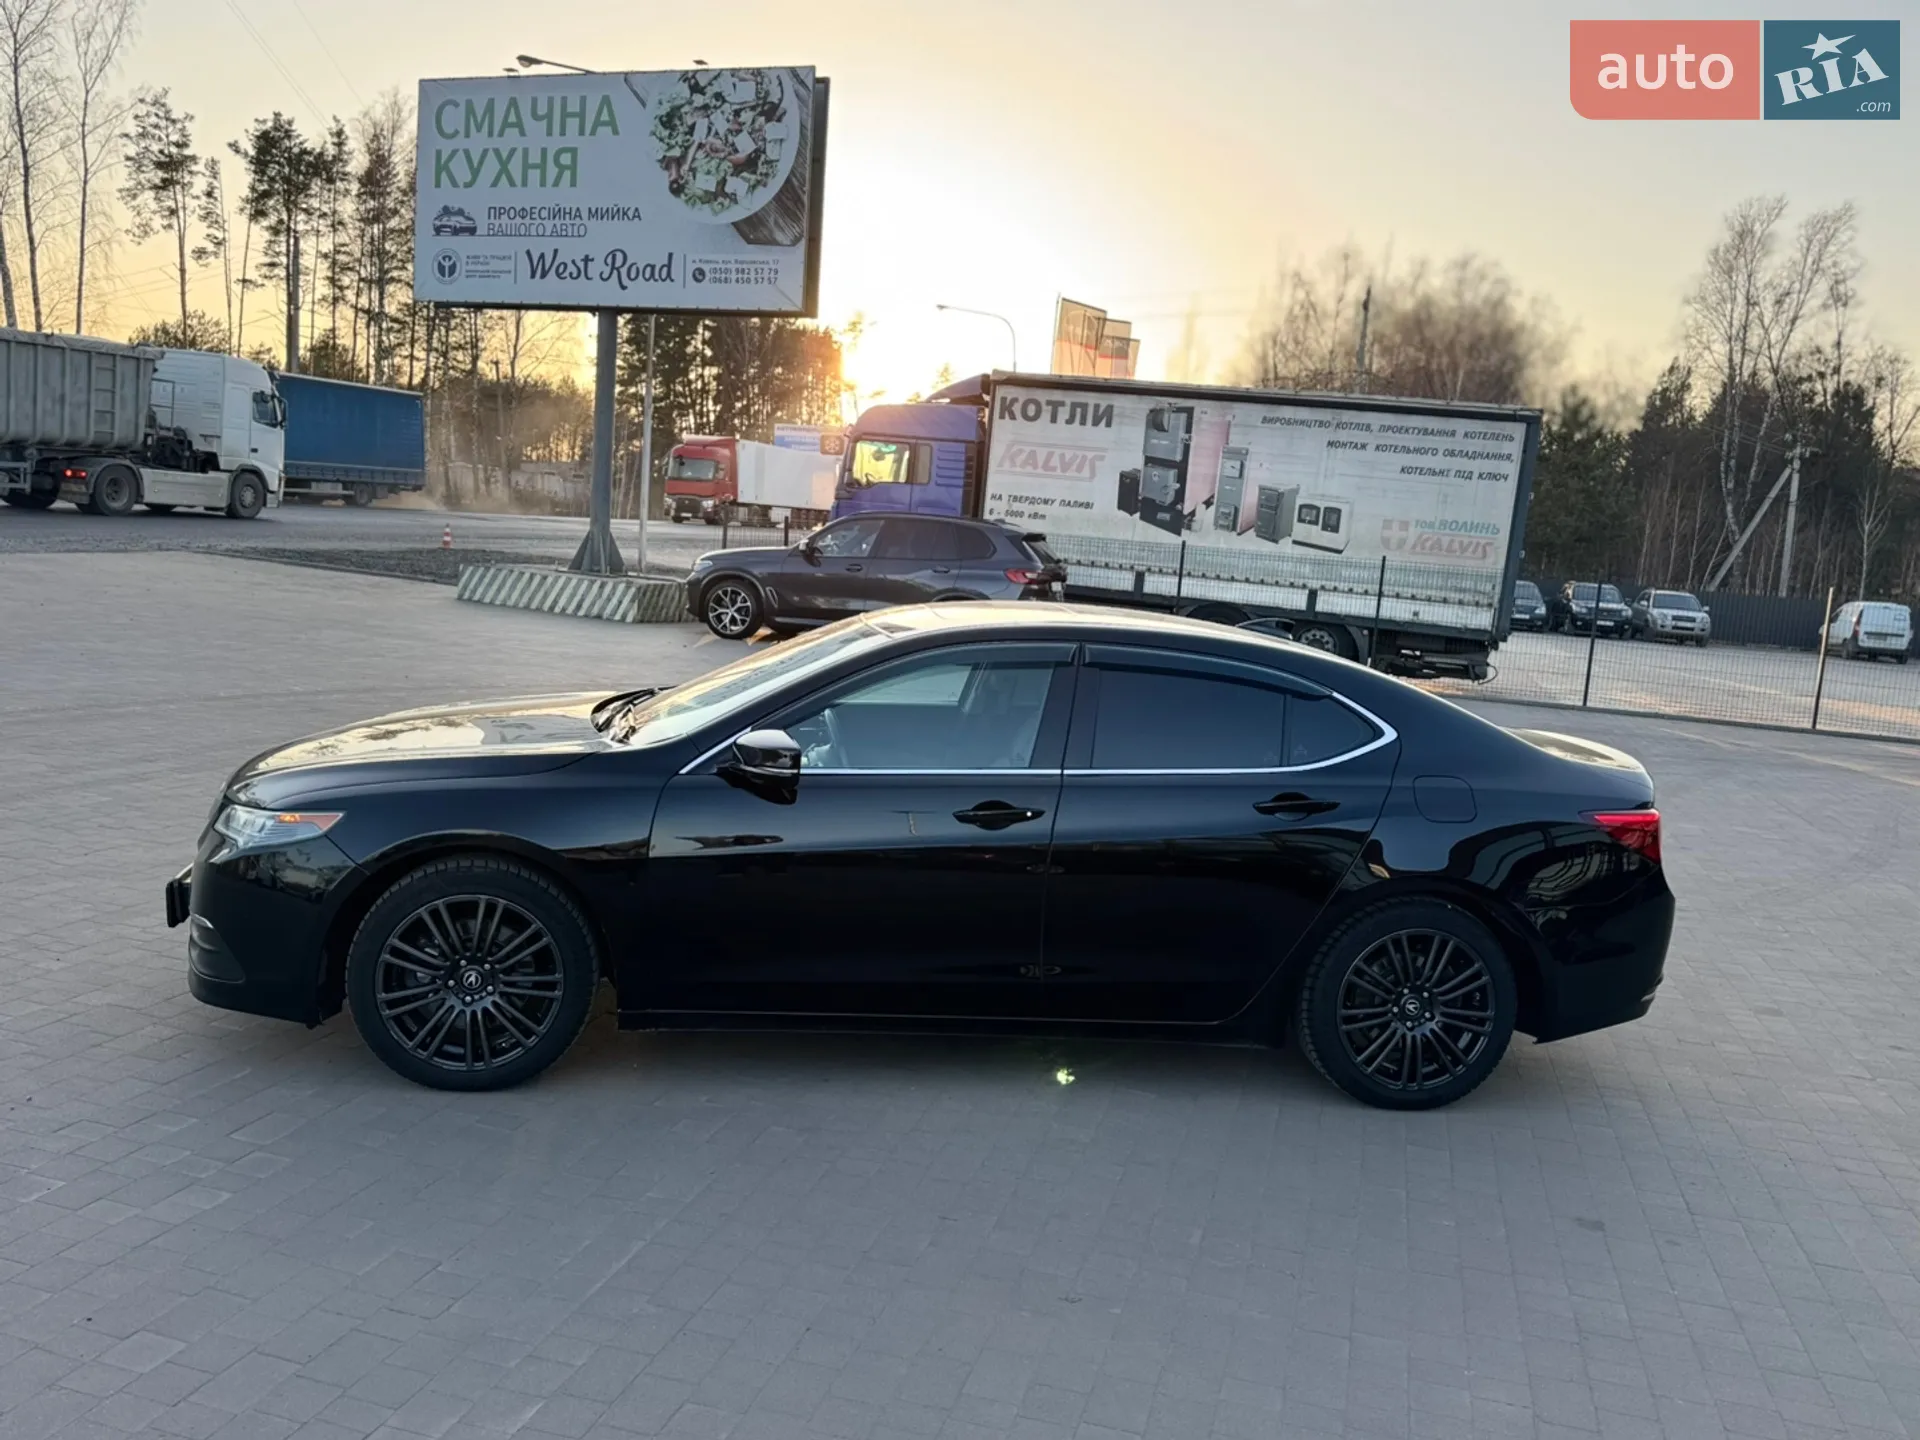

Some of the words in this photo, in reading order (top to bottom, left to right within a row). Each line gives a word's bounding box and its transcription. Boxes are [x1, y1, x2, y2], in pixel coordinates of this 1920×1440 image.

[434, 94, 620, 140] СМАЧНА
[434, 146, 579, 189] КУХНЯ
[487, 206, 583, 221] ПРОФЕСІЙНА
[588, 205, 642, 221] МИЙКА
[487, 222, 546, 237] ВАШОГО
[551, 223, 587, 237] АВТО
[525, 248, 594, 280] West
[599, 248, 675, 290] Road
[708, 267, 732, 275] (050)
[998, 396, 1114, 428] КОТЛИ
[1261, 415, 1331, 429] ВИРОБНИЦТВО
[1334, 420, 1374, 433] КОТЛІВ,
[1462, 430, 1515, 442] КОТЕЛЕНЬ
[1326, 440, 1369, 451] МОНТАЖ
[1374, 443, 1439, 456] КОТЕЛЬНОГО
[1442, 448, 1514, 463] ОБЛАДНАННЯ,
[1400, 465, 1451, 477] КОТЕЛЬНІ
[1453, 469, 1474, 480] ПІД
[1477, 471, 1509, 482] КЛЮЧ
[990, 493, 1002, 501] НА
[1008, 494, 1056, 505] ТВЕРДОМУ
[1058, 498, 1094, 510] ПАЛИВІ
[988, 507, 994, 516] 6
[1004, 509, 1025, 518] 5000
